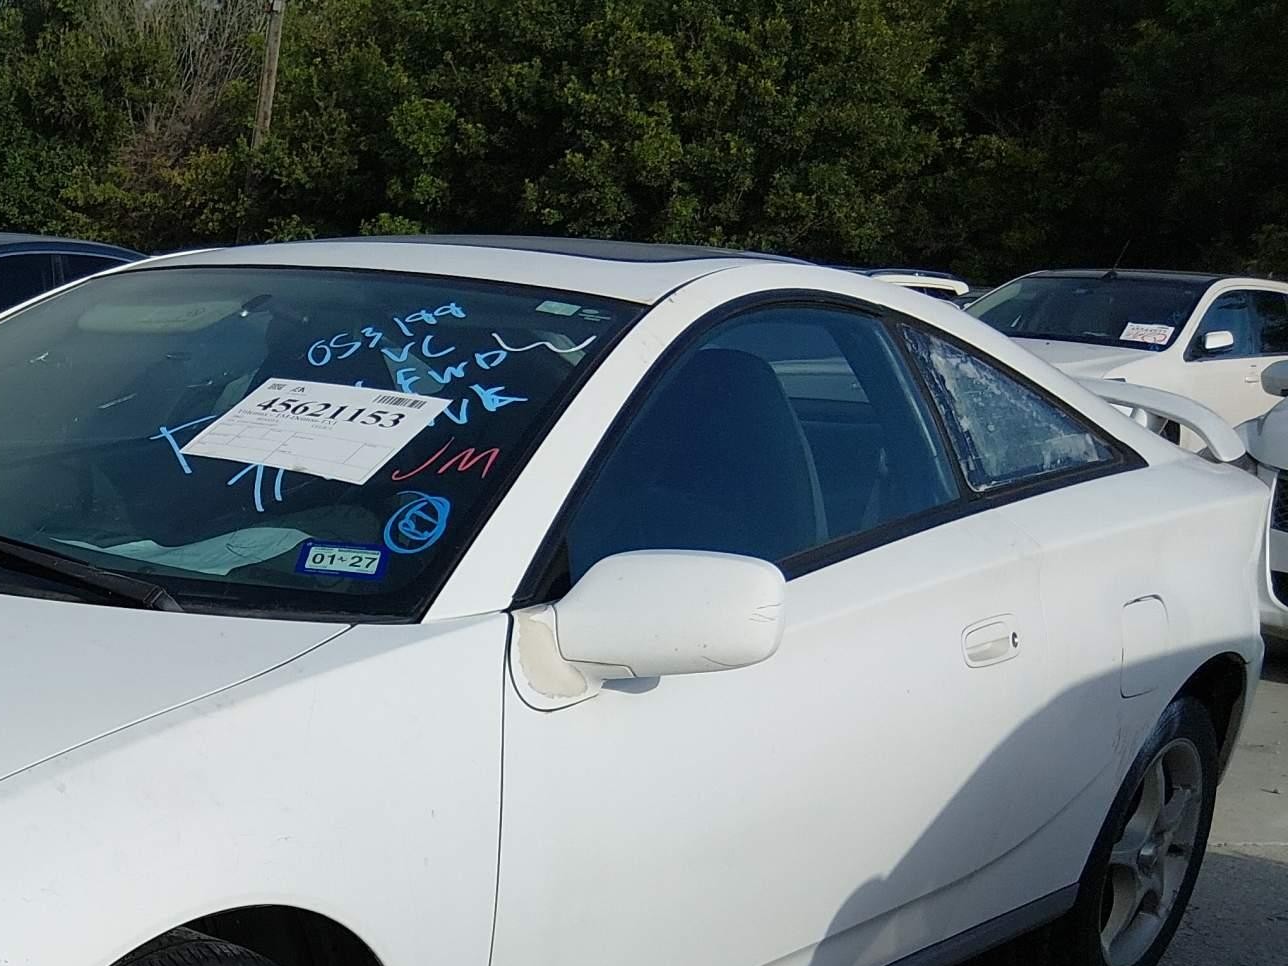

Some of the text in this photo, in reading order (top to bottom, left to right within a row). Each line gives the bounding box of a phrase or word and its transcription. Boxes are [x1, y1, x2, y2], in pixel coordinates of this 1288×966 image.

[256, 396, 407, 429] 45621153
[391, 436, 500, 480] JM
[311, 552, 337, 566] 01
[348, 555, 379, 569] 27
